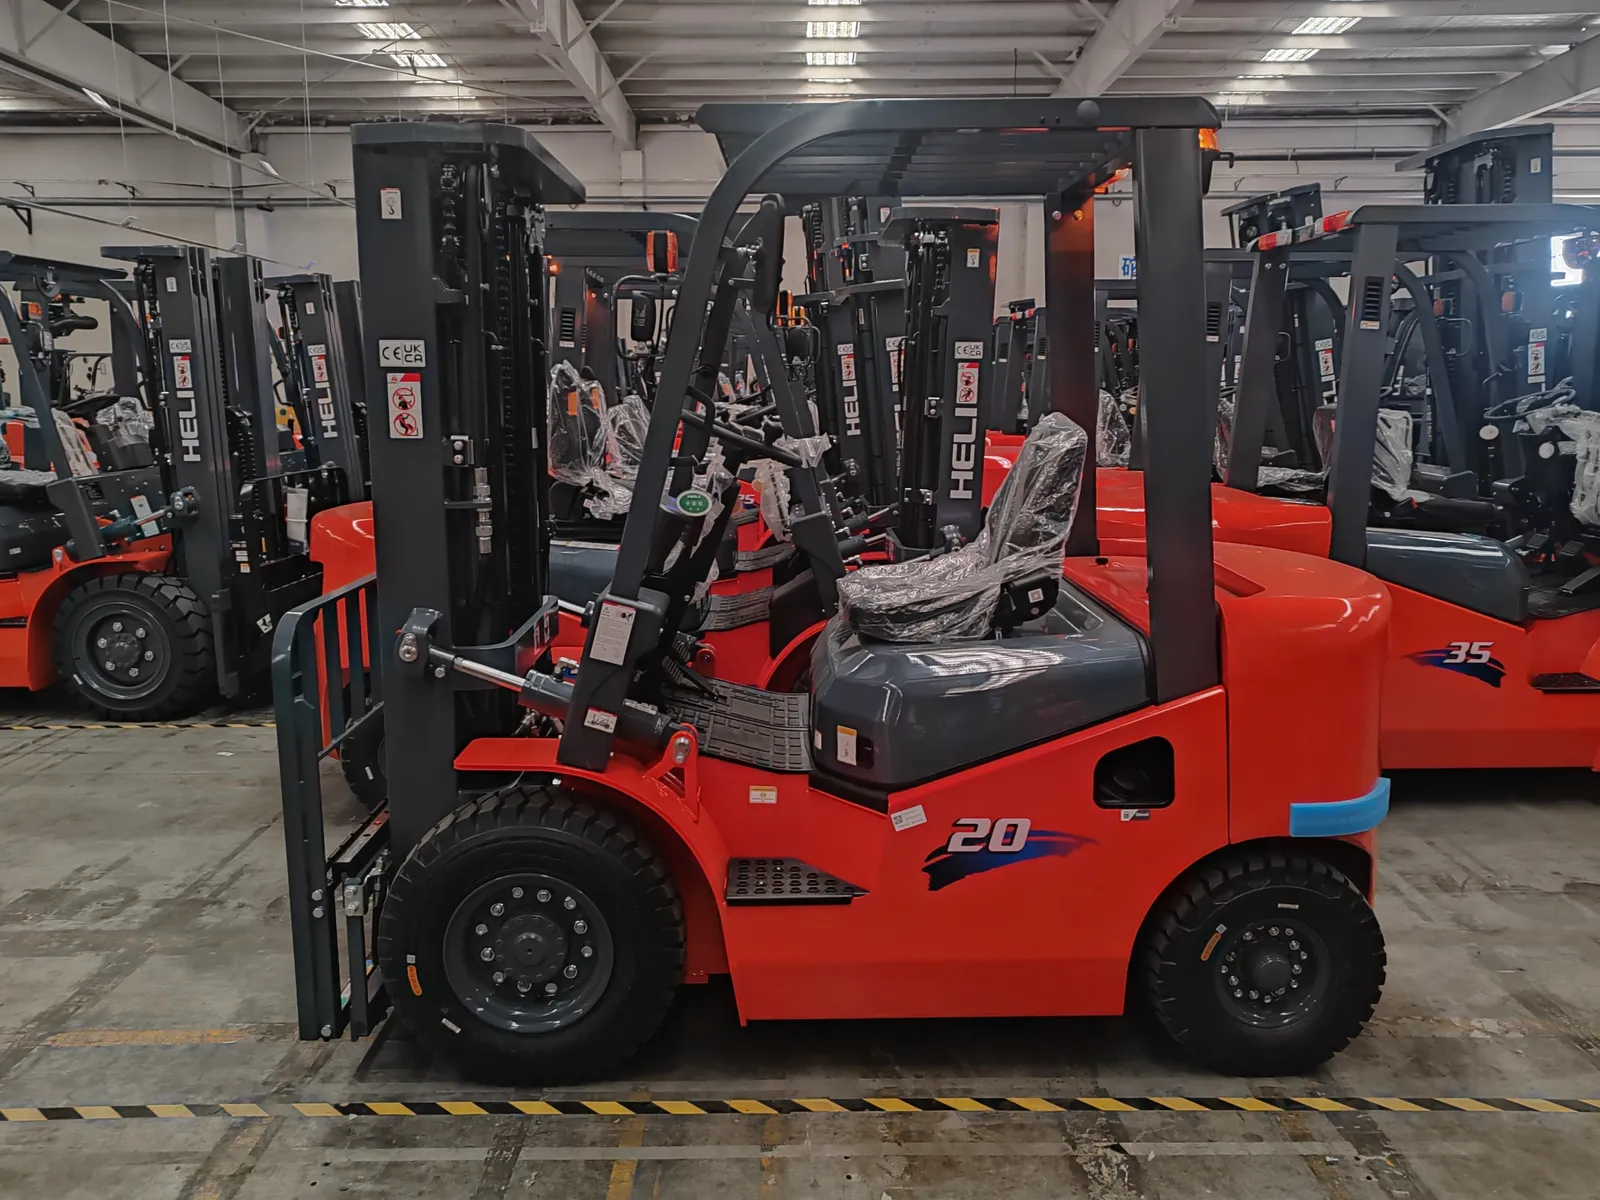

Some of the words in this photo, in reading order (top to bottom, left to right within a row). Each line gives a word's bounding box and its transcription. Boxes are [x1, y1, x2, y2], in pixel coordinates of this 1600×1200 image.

[382, 346, 401, 360] CE
[404, 344, 421, 353] UK
[404, 354, 423, 363] CA
[956, 345, 970, 355] CE
[315, 381, 338, 438] HELI
[842, 380, 861, 436] HELI
[176, 390, 201, 462] HELI
[949, 407, 978, 499] HELI
[1442, 641, 1495, 664] 35
[947, 817, 1031, 853] 20
